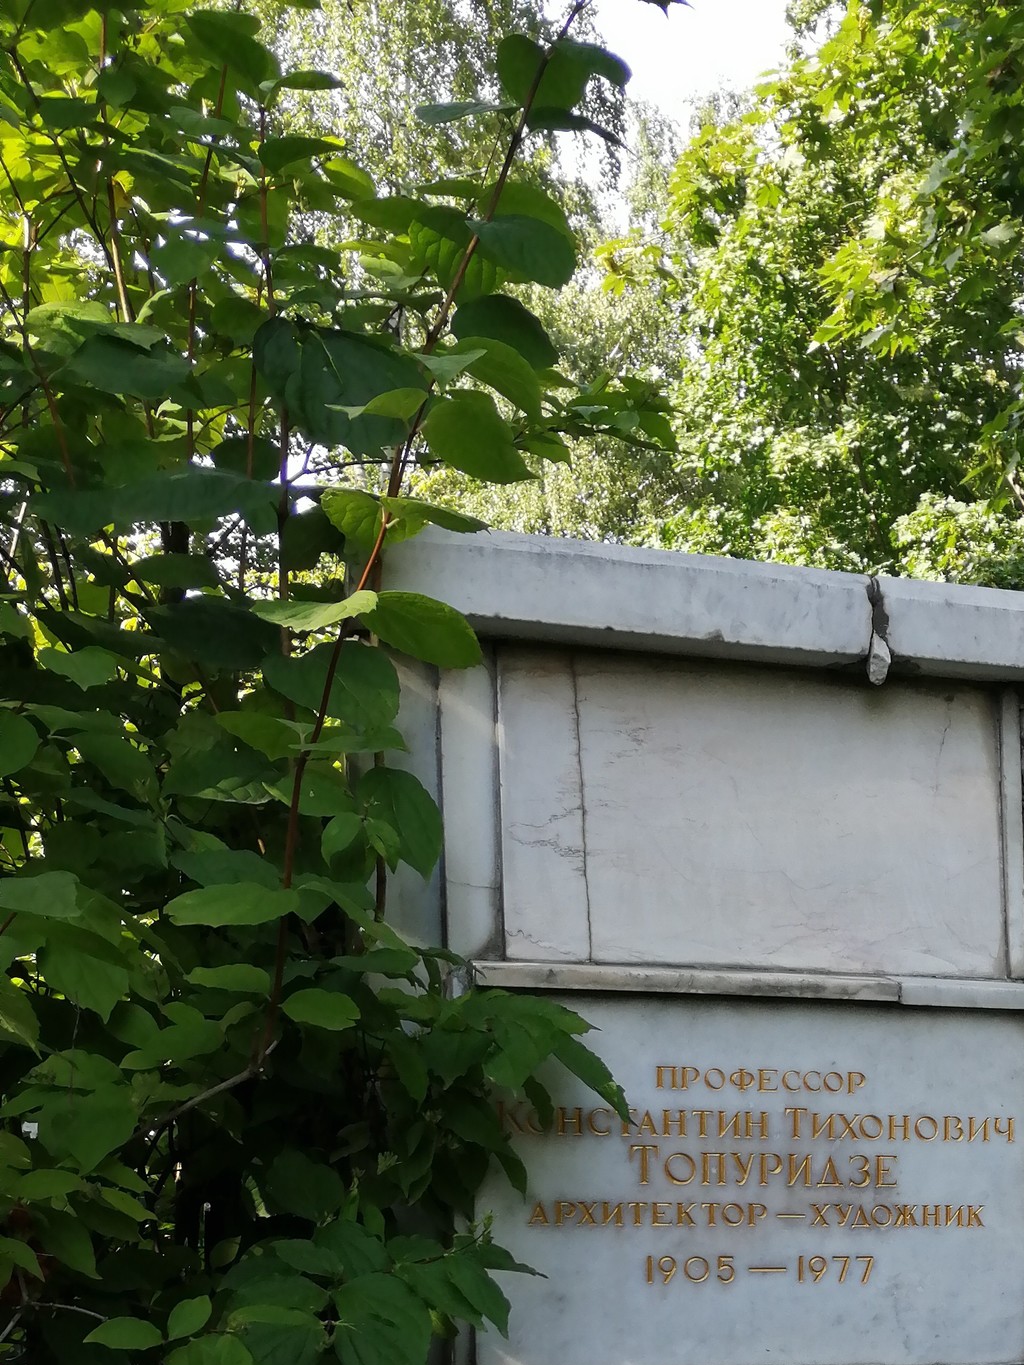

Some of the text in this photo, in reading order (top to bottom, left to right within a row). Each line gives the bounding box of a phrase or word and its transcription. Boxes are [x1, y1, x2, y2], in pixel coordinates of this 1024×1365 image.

[656, 1065, 867, 1095] ПРОФЕССОР
[784, 1108, 1017, 1145] ТИХОНОВИЧ
[629, 1144, 900, 1189] ТОПУРИДЗЕ
